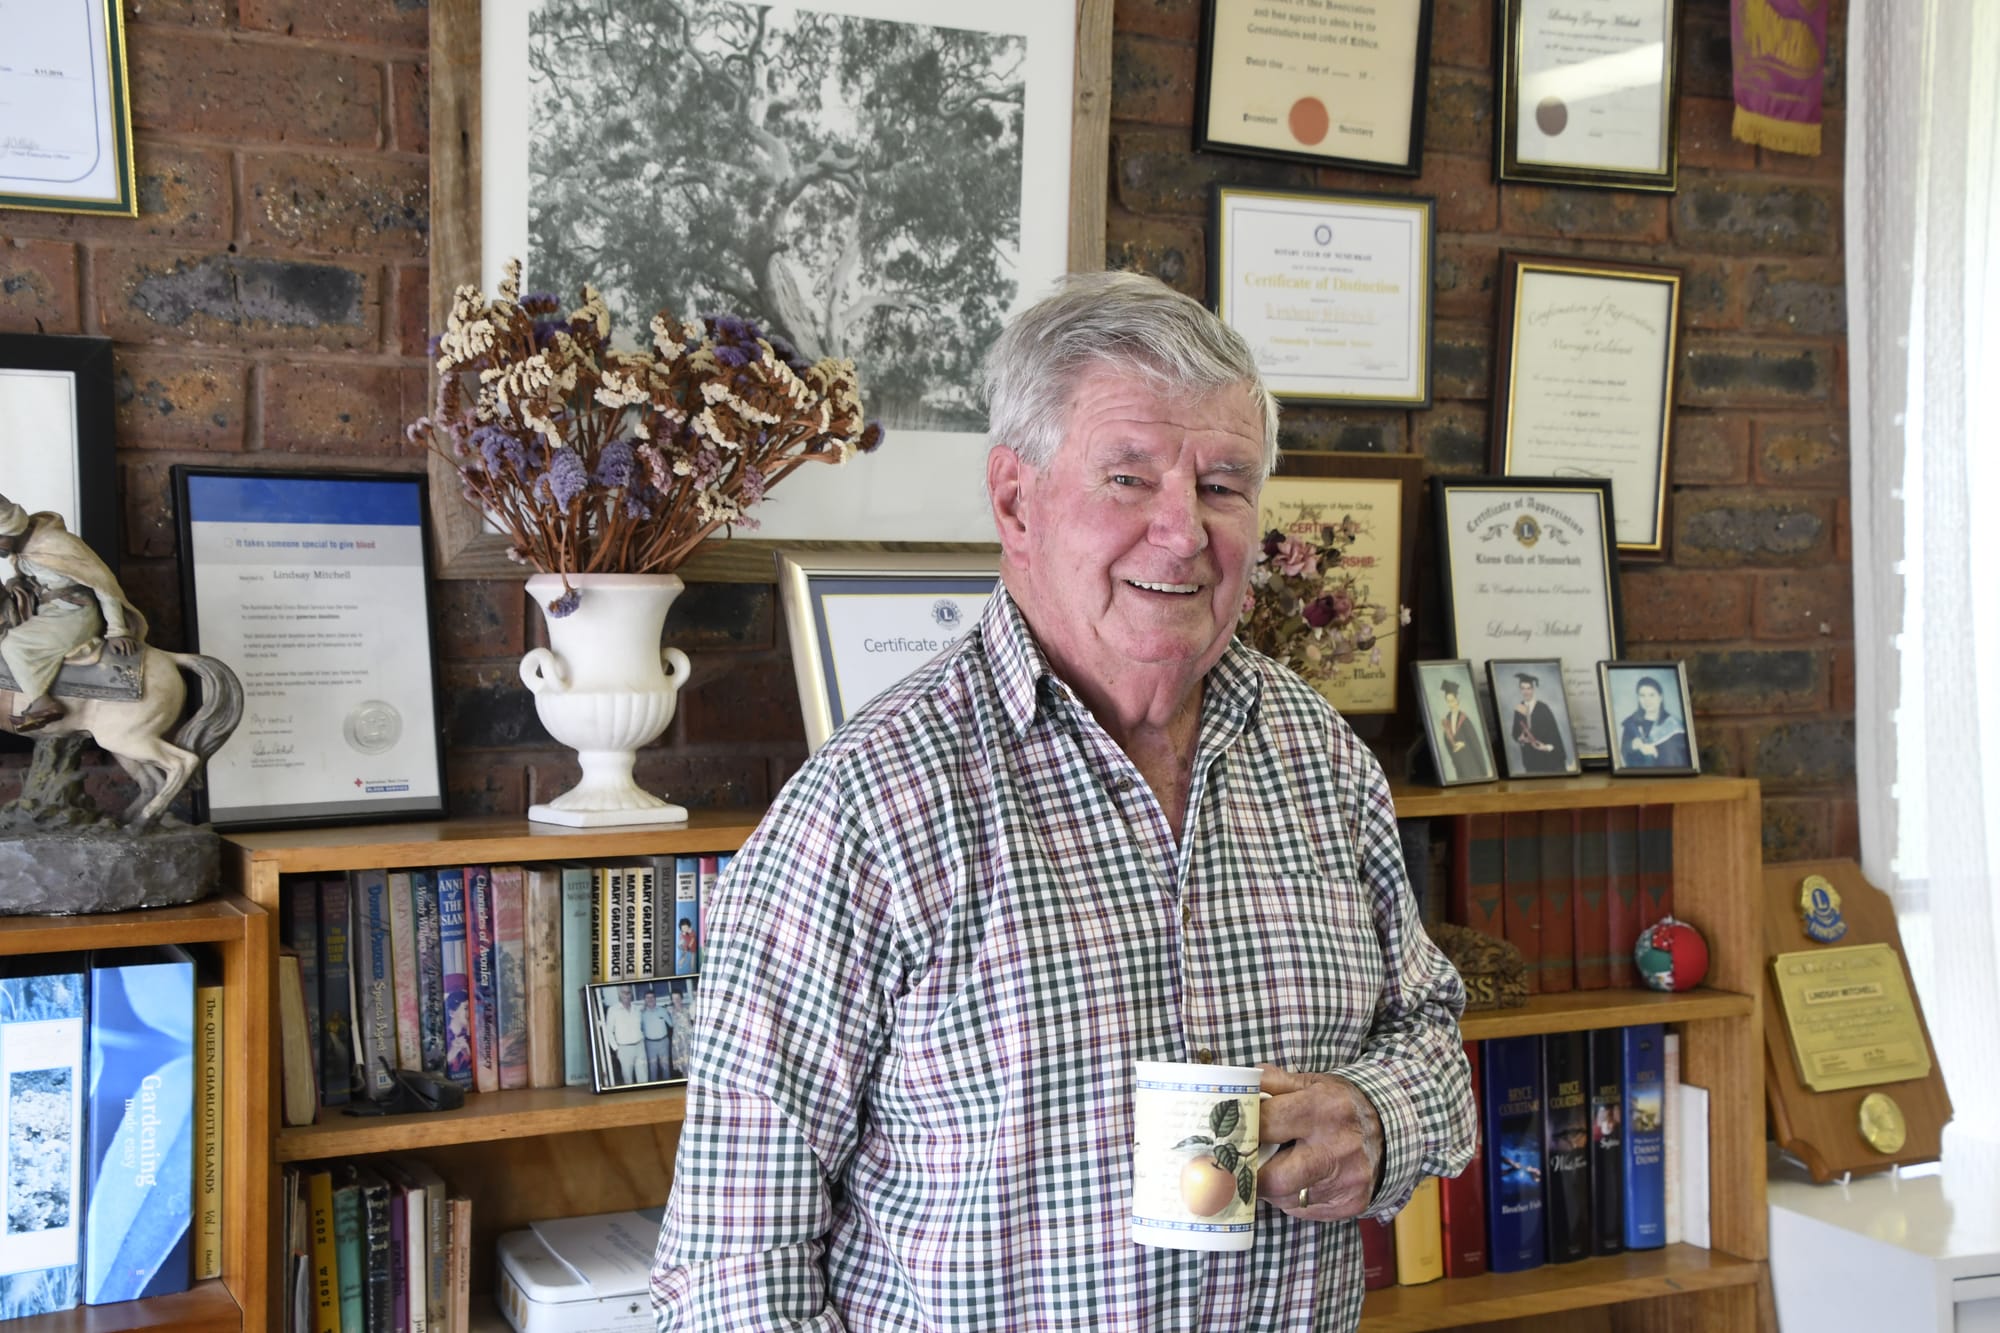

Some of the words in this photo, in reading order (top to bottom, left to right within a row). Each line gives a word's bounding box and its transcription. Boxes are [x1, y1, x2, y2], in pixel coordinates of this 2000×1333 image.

[1244, 271, 1312, 291] Certificate
[1315, 273, 1329, 291] of
[1332, 276, 1400, 294] Distinction
[1466, 501, 1511, 534] Certificate
[1514, 496, 1524, 508] of
[1526, 496, 1584, 536] Appreciation
[244, 539, 265, 549] takes
[266, 540, 300, 550] someone
[301, 540, 328, 550] special
[329, 540, 338, 549] to
[338, 541, 354, 551] give
[272, 570, 311, 581] Lindsay
[313, 570, 351, 580] Mitchell
[864, 637, 939, 653] Certificate
[1352, 668, 1386, 681] March
[476, 874, 488, 929] Chronicles
[591, 876, 599, 906] MARY
[611, 876, 621, 906] MARY
[626, 874, 635, 904] MARY
[643, 874, 652, 904] MARY
[479, 930, 489, 942] of
[591, 906, 599, 942] GRANT
[611, 907, 621, 942] GRANT
[626, 905, 635, 940] GRANT
[643, 905, 652, 940] GRANT
[479, 944, 490, 986] Avonlea
[611, 944, 621, 976] BRUCE
[626, 942, 635, 974] BRUCE
[643, 942, 652, 974] BRUCE
[661, 938, 671, 968] LUCK
[207, 997, 216, 1019] The
[373, 982, 386, 1020] Special
[206, 1021, 216, 1063] QUEEN
[376, 1022, 387, 1051] Agent
[205, 1066, 216, 1140] CHARLOTTE
[1559, 1081, 1580, 1095] BRYCE
[123, 1098, 134, 1134] made
[135, 1074, 162, 1187] Gardening
[119, 1135, 135, 1169] easy
[204, 1142, 215, 1194] ISLANDS
[315, 1208, 327, 1245] LOOK
